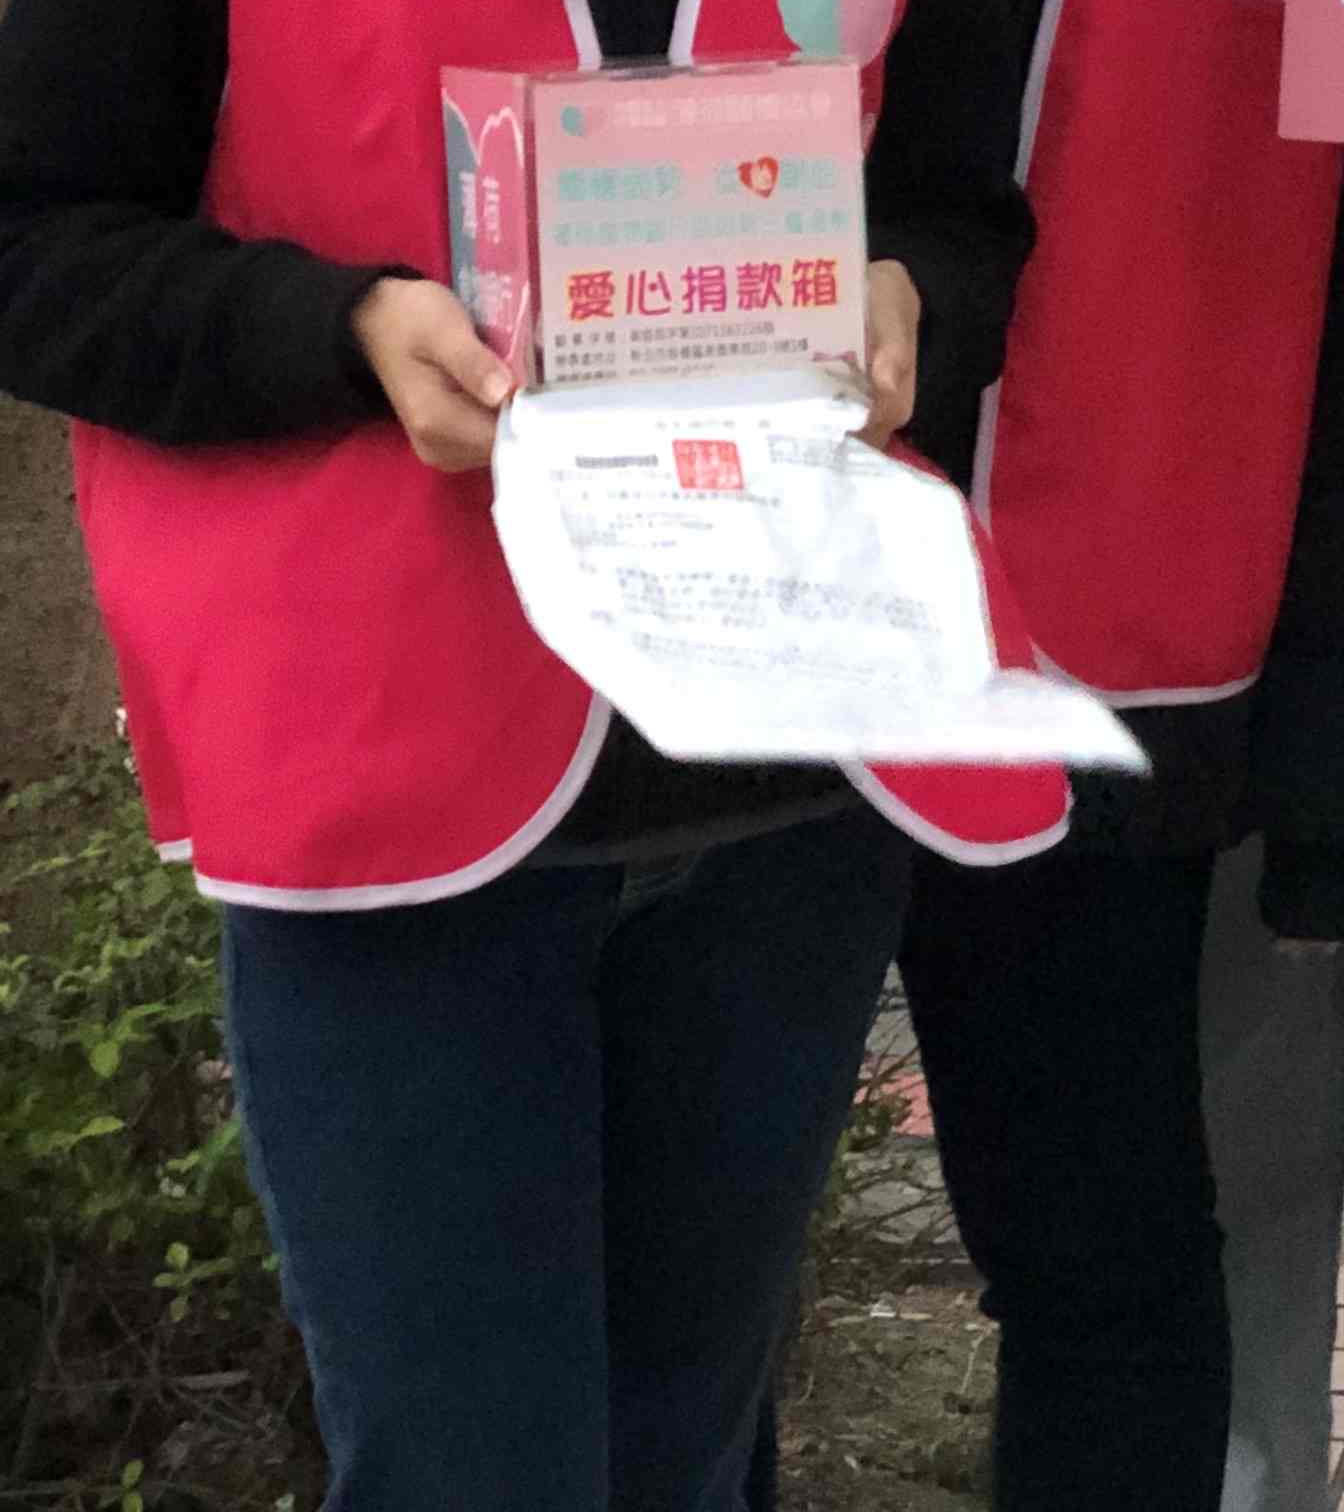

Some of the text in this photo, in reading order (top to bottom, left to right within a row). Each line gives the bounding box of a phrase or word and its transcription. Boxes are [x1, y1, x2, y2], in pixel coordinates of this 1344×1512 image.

[567, 256, 839, 321] 愛心捐款箱
